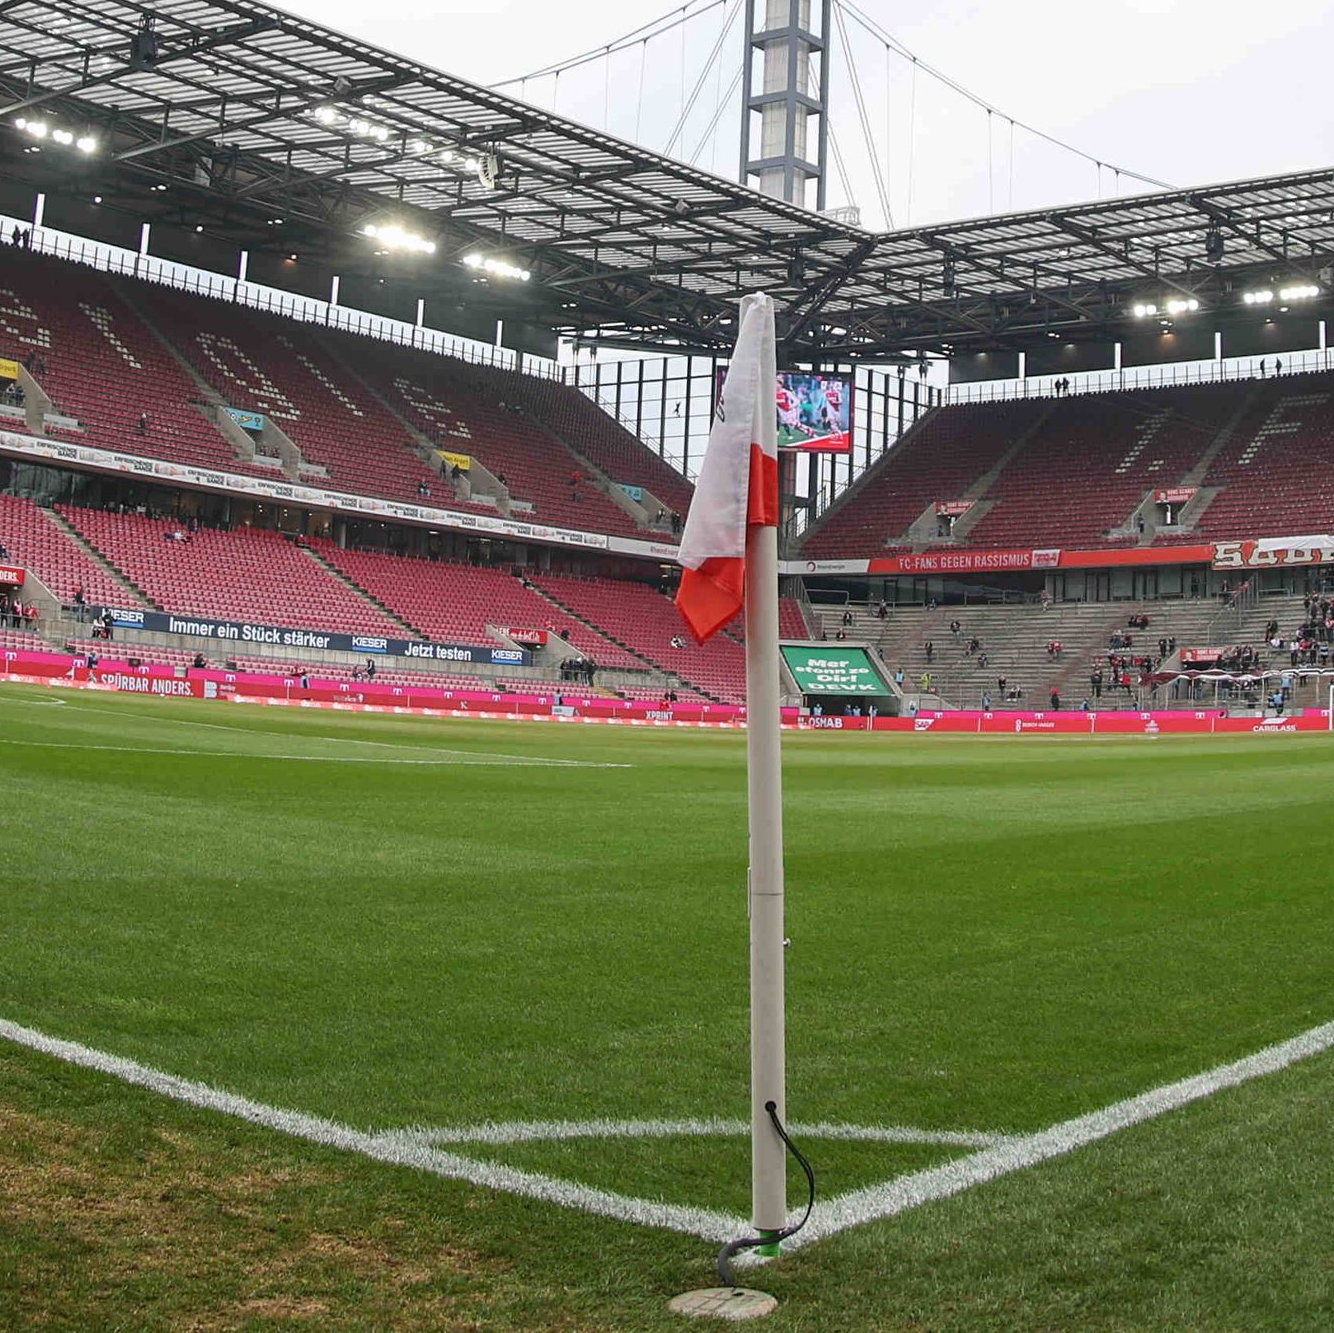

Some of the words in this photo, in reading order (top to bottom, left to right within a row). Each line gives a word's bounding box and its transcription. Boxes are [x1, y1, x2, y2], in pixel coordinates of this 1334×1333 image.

[899, 556, 939, 570] FC-FANS
[940, 555, 972, 569] GEGEN
[974, 552, 1030, 568] RASSISMUS
[169, 616, 215, 635] Immer
[217, 625, 238, 639] ein
[242, 625, 280, 645] Stück
[284, 630, 329, 648] stärker
[352, 636, 387, 649] KIESER
[405, 642, 434, 657] Jetzt
[436, 647, 472, 662] testen
[491, 649, 523, 661] KIESER
[100, 672, 149, 693] SPÜRBAR
[151, 679, 194, 696] ANDERS.
[807, 683, 877, 691] DEVK
